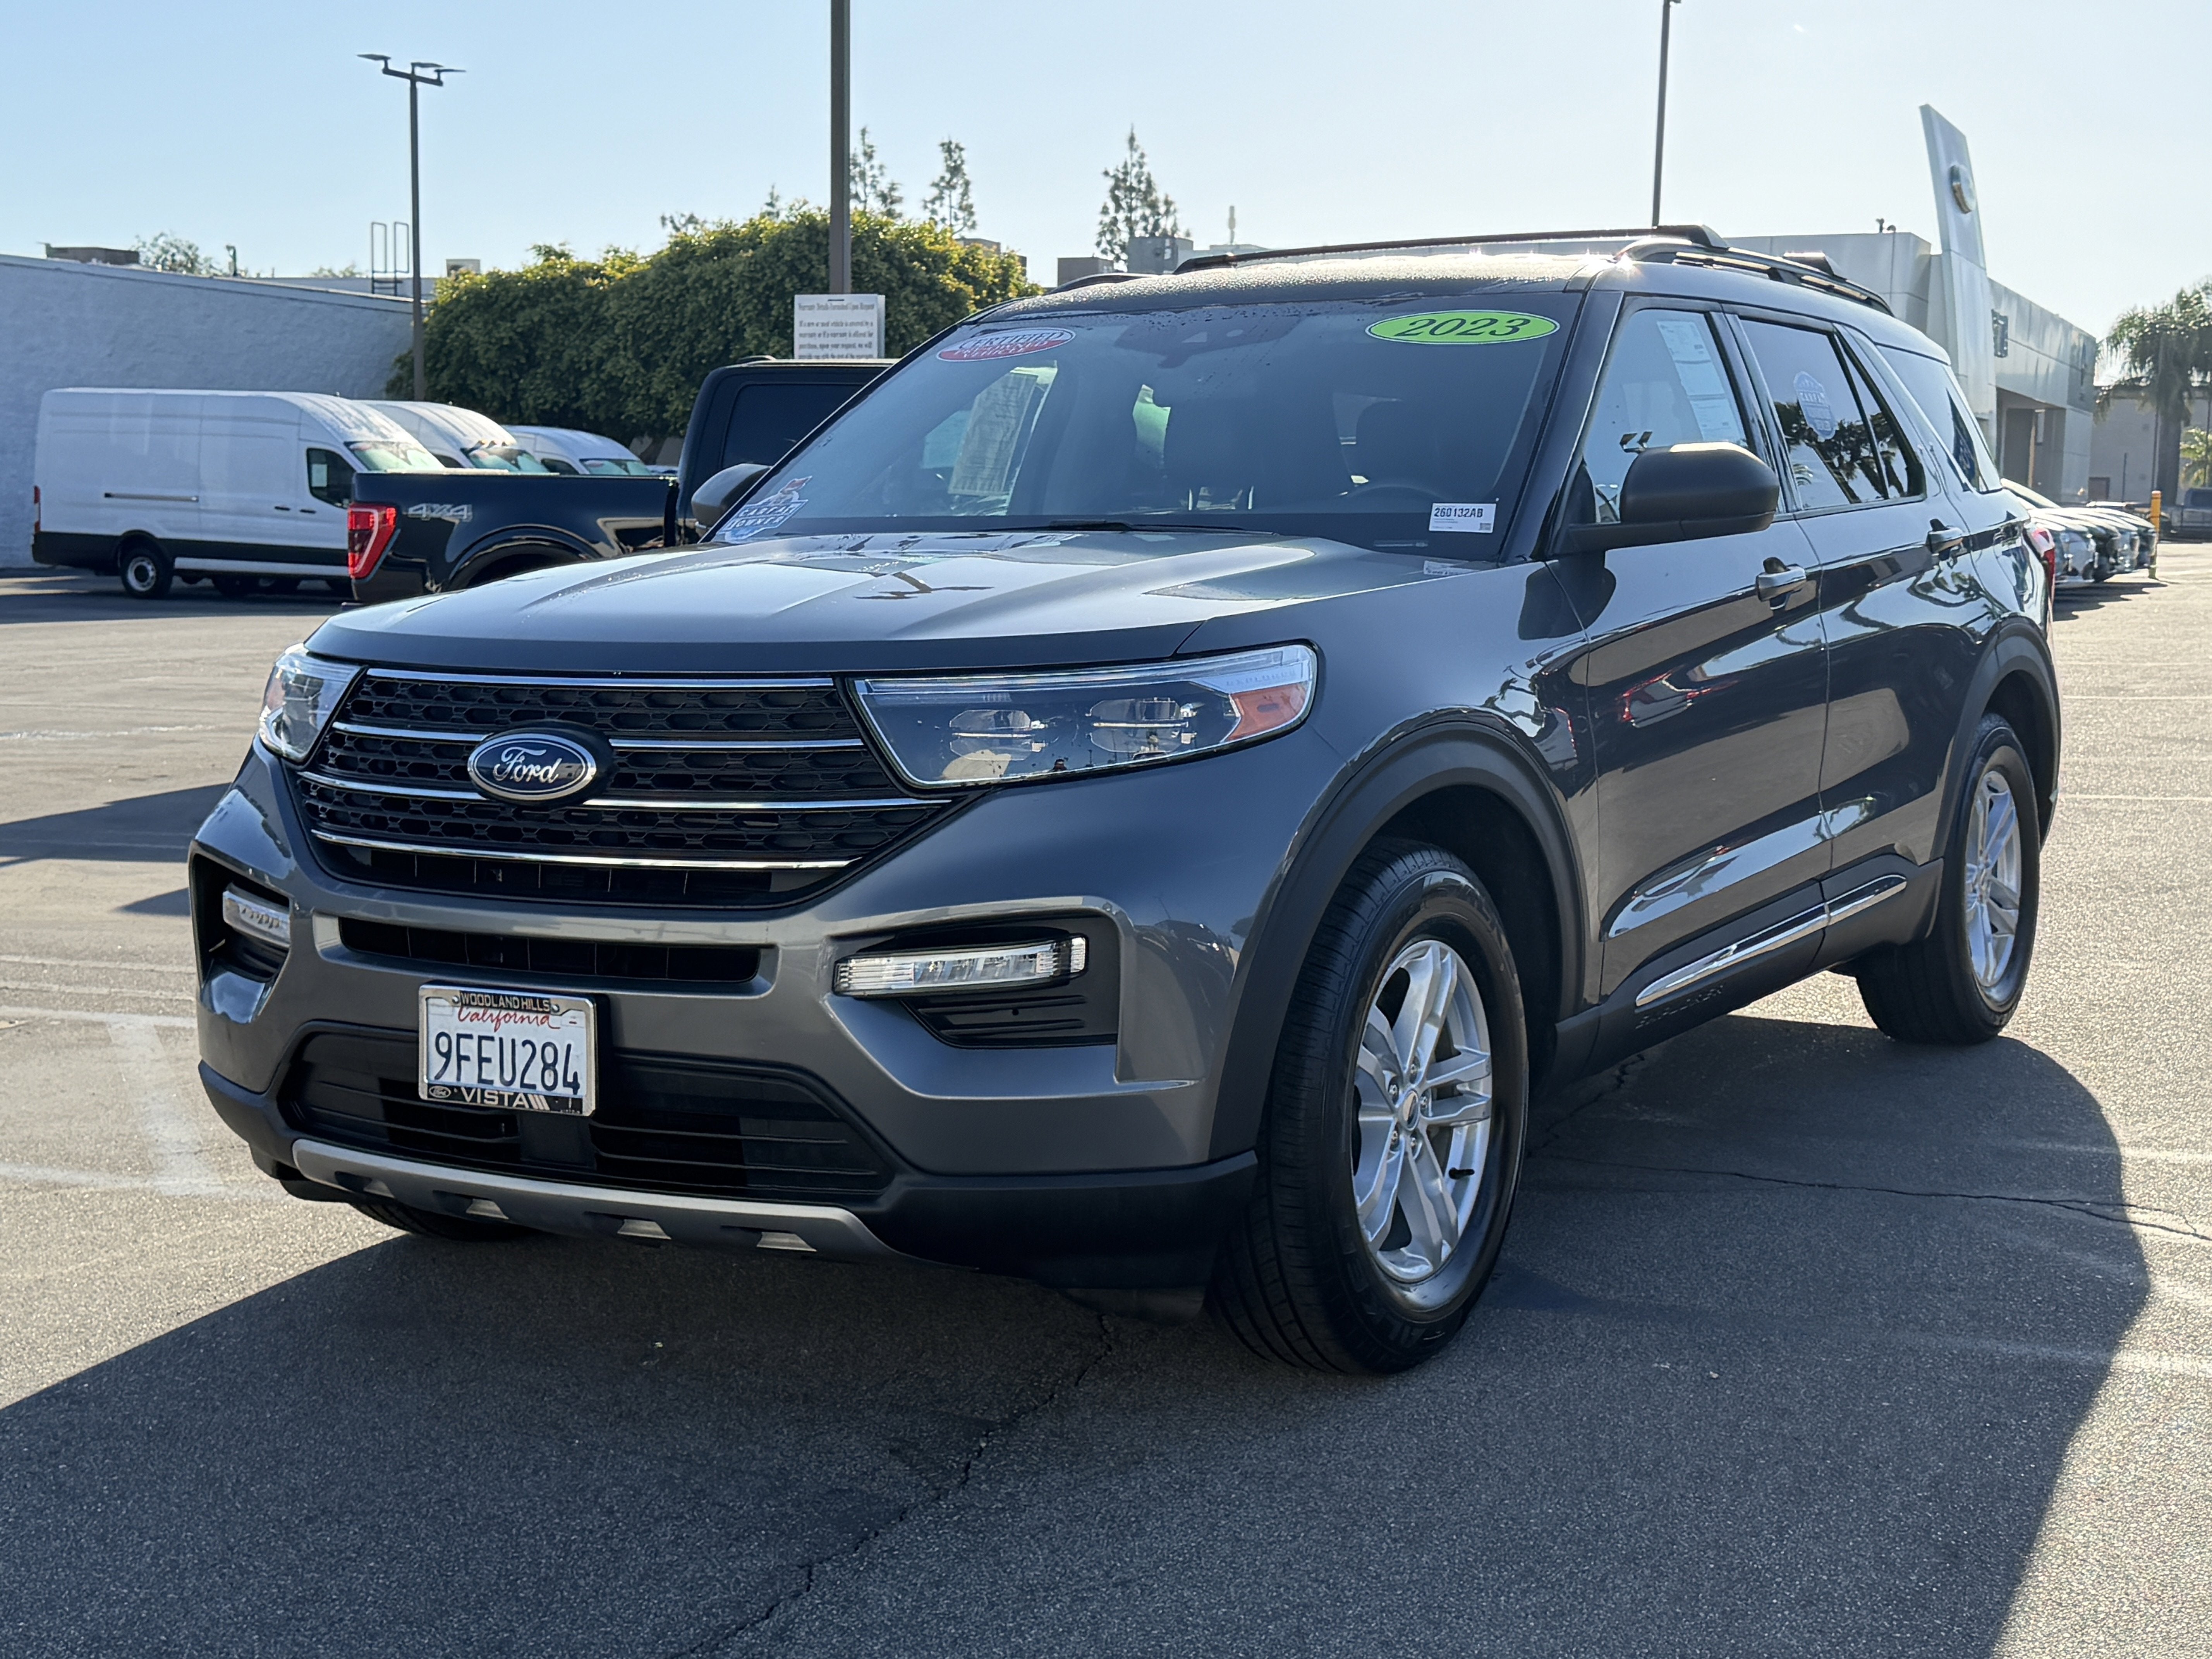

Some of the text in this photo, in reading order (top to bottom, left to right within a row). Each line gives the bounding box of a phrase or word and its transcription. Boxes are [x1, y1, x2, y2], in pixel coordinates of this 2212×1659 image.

[1393, 318, 1531, 337] 2023
[1434, 508, 1484, 518] 260132AB
[493, 747, 562, 783] Ford
[460, 992, 550, 1012] WOODLAND HILLS
[458, 1006, 561, 1032] California
[434, 1031, 580, 1095] 9FEU284
[461, 1087, 530, 1109] VISTA
